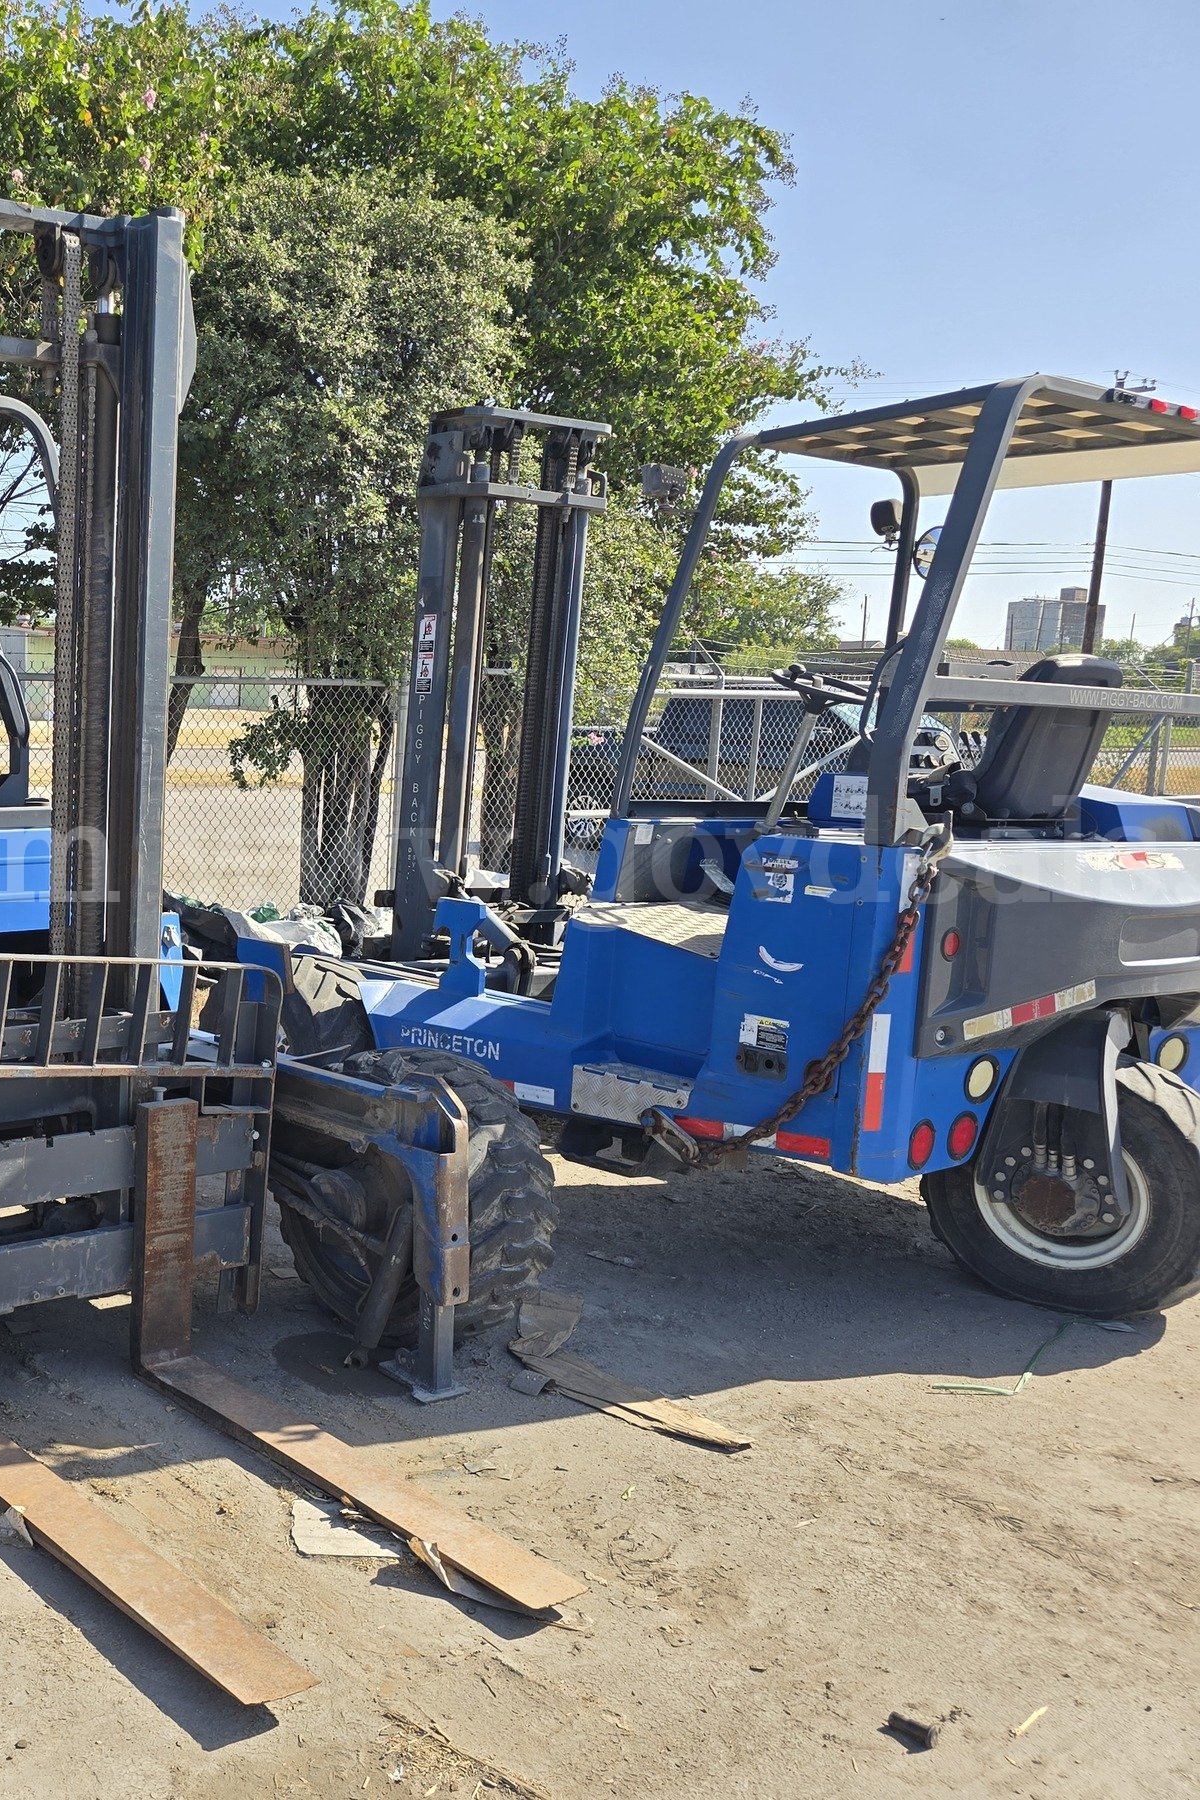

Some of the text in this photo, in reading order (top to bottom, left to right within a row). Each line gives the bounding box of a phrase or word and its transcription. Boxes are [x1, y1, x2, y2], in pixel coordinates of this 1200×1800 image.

[1070, 689, 1183, 710] WWW.PIGGY-BACK.COM
[415, 695, 426, 764] PIGGY
[409, 783, 419, 837] BACK
[400, 1025, 500, 1061] PRINCETON
